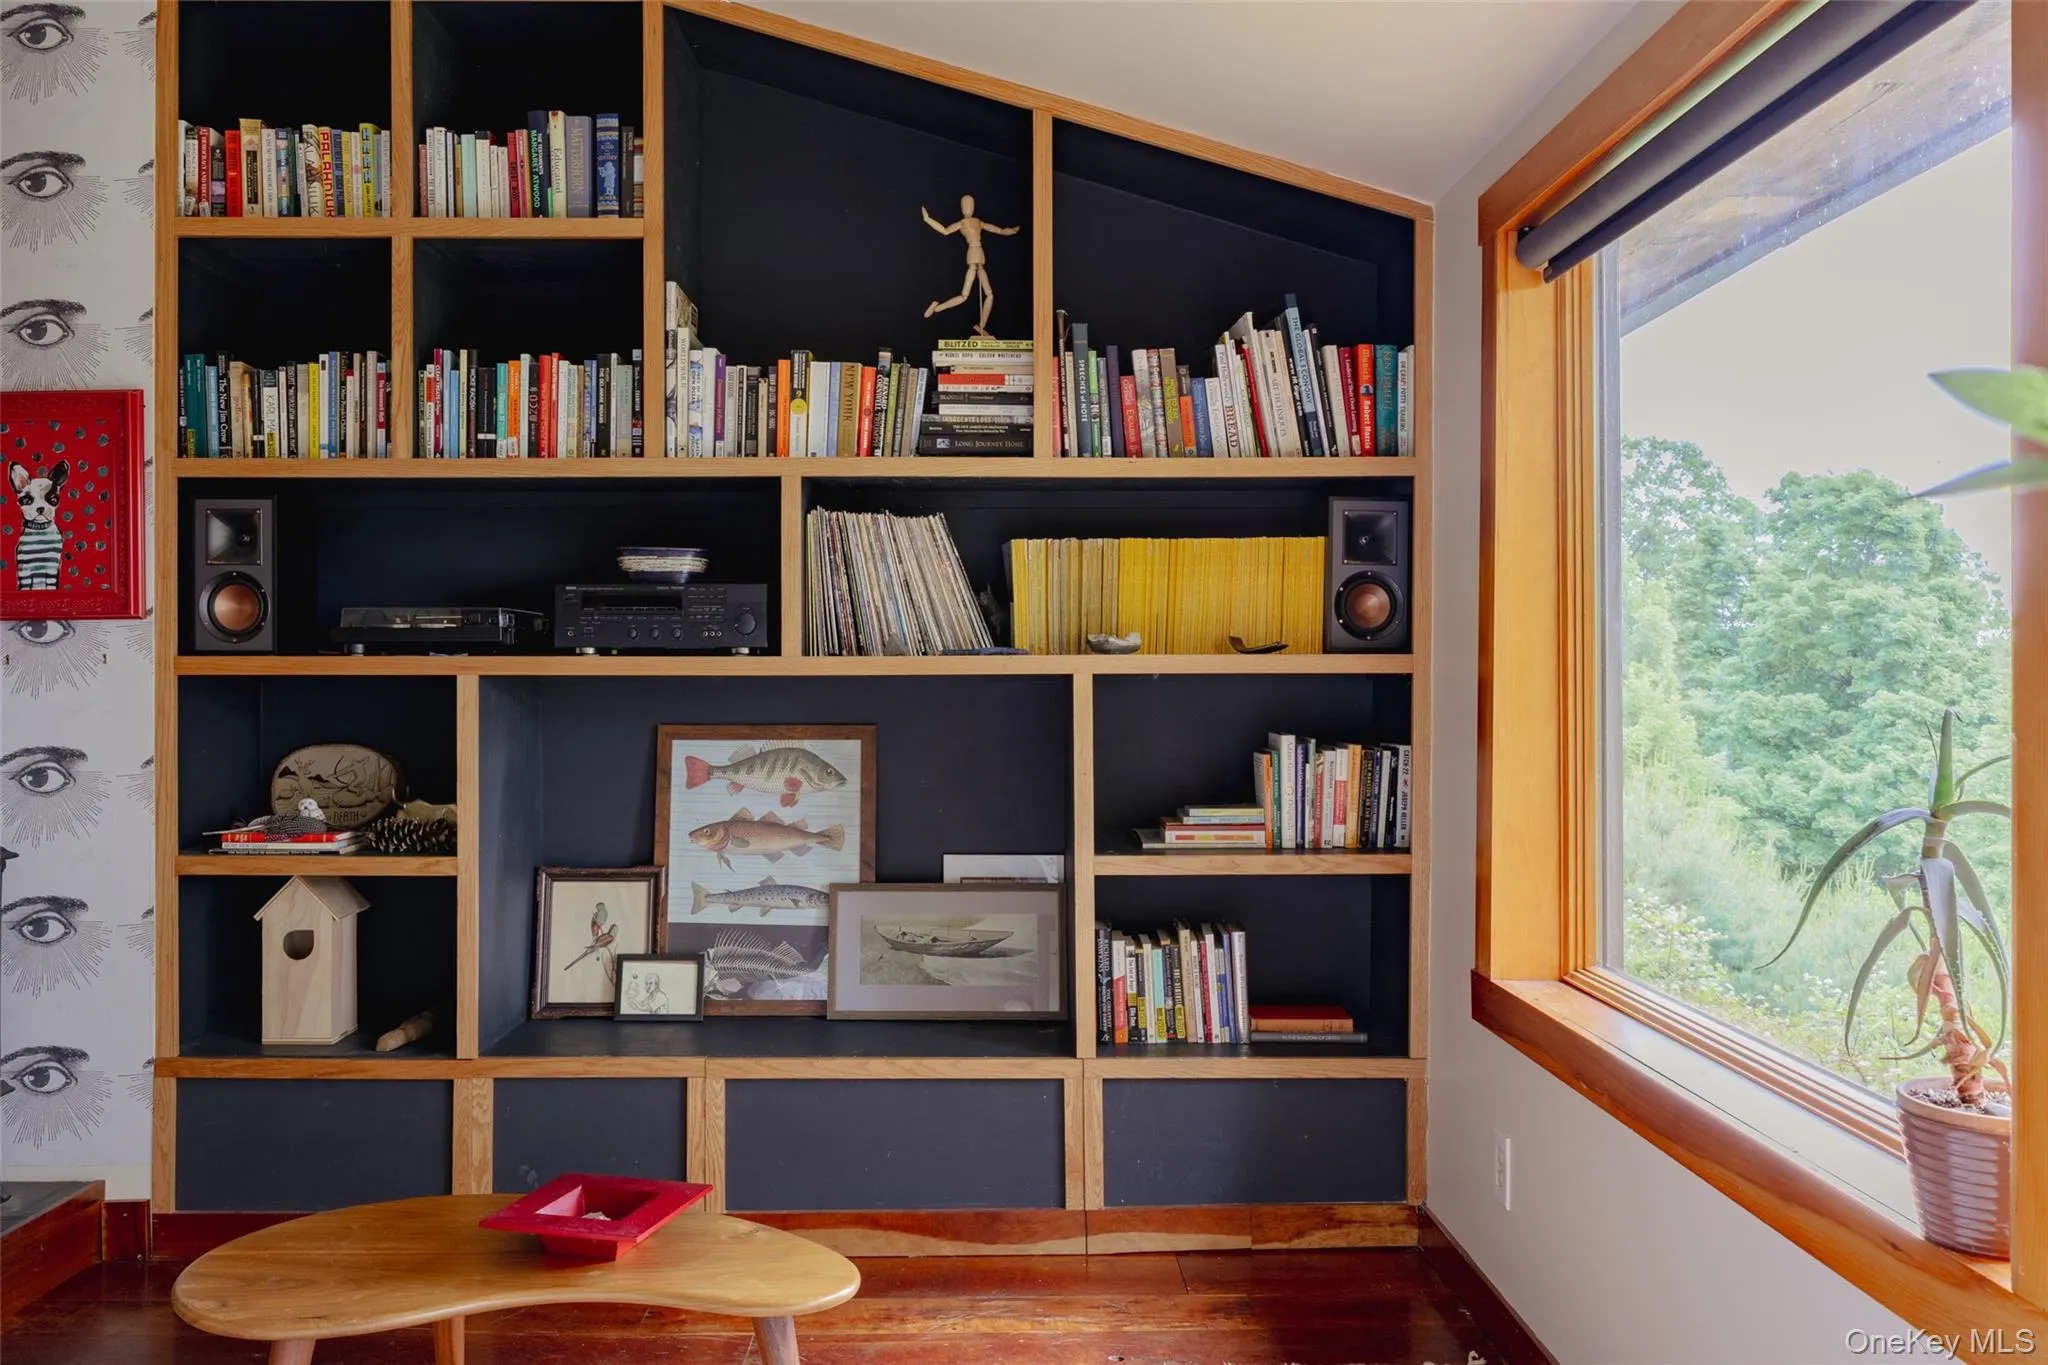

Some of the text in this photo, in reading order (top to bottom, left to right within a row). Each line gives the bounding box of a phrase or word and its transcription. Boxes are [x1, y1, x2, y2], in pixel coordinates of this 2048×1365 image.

[554, 148, 563, 193] Educated
[532, 174, 540, 208] ATWOOD
[1294, 333, 1304, 362] GLOBAL
[1301, 364, 1312, 404] ECONOMY
[843, 365, 856, 422] NEW YORK
[875, 374, 883, 410] CORNWELL
[219, 410, 228, 422] Jim
[268, 419, 276, 432] MA
[1224, 405, 1237, 448] BREAD
[1274, 392, 1286, 437] TECHNIQUES
[1349, 411, 1357, 432] Learning
[1364, 400, 1372, 424] Robert
[955, 440, 974, 448] LONG
[975, 440, 1004, 448] JOURNEY
[1364, 426, 1372, 448] Harris
